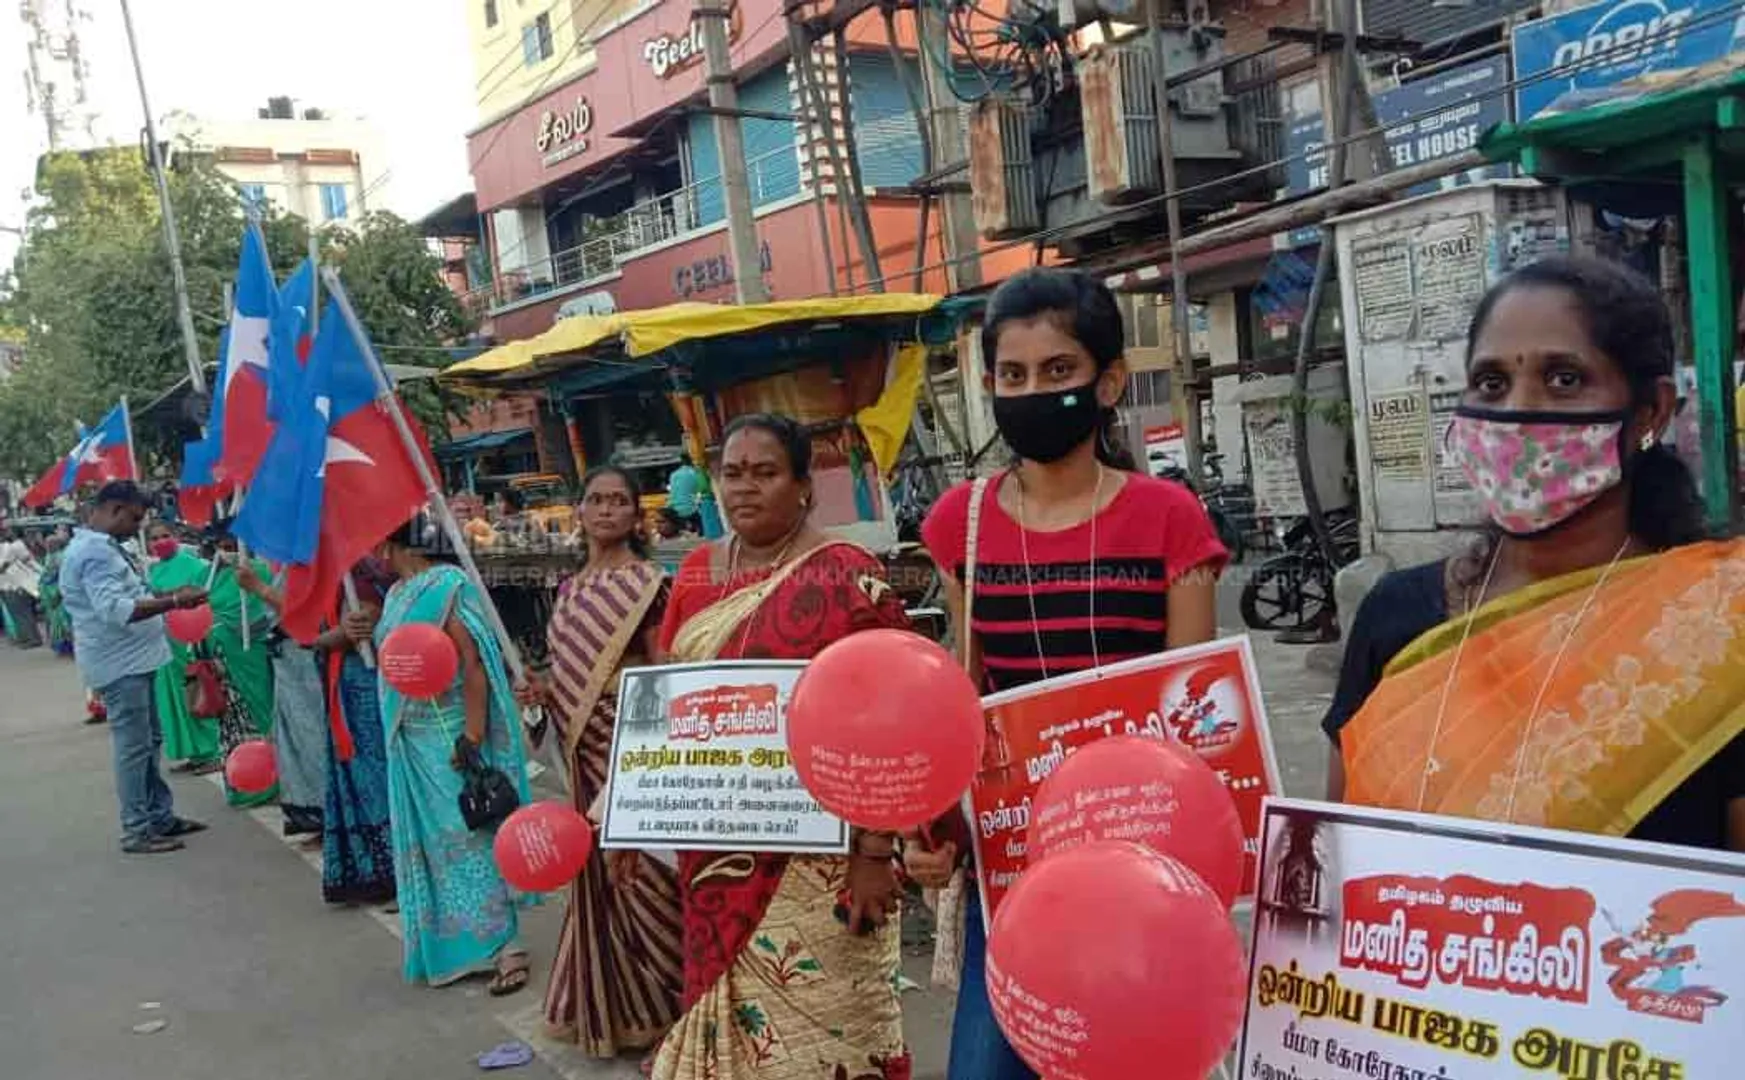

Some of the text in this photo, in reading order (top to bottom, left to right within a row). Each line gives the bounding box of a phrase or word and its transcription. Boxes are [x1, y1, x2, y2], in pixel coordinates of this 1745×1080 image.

[1553, 8, 1693, 78] ORBIT
[670, 701, 774, 738] மனித சங்கிலி
[621, 744, 681, 772] ஒன்றிய
[1377, 884, 1523, 915] தமிழகம் தழுவிய
[1342, 908, 1584, 993] மனித சங்கிலி
[1258, 959, 1365, 1025] ஒன்றிய
[1371, 997, 1498, 1058] பாஜக
[1283, 1022, 1320, 1059] பீமா
